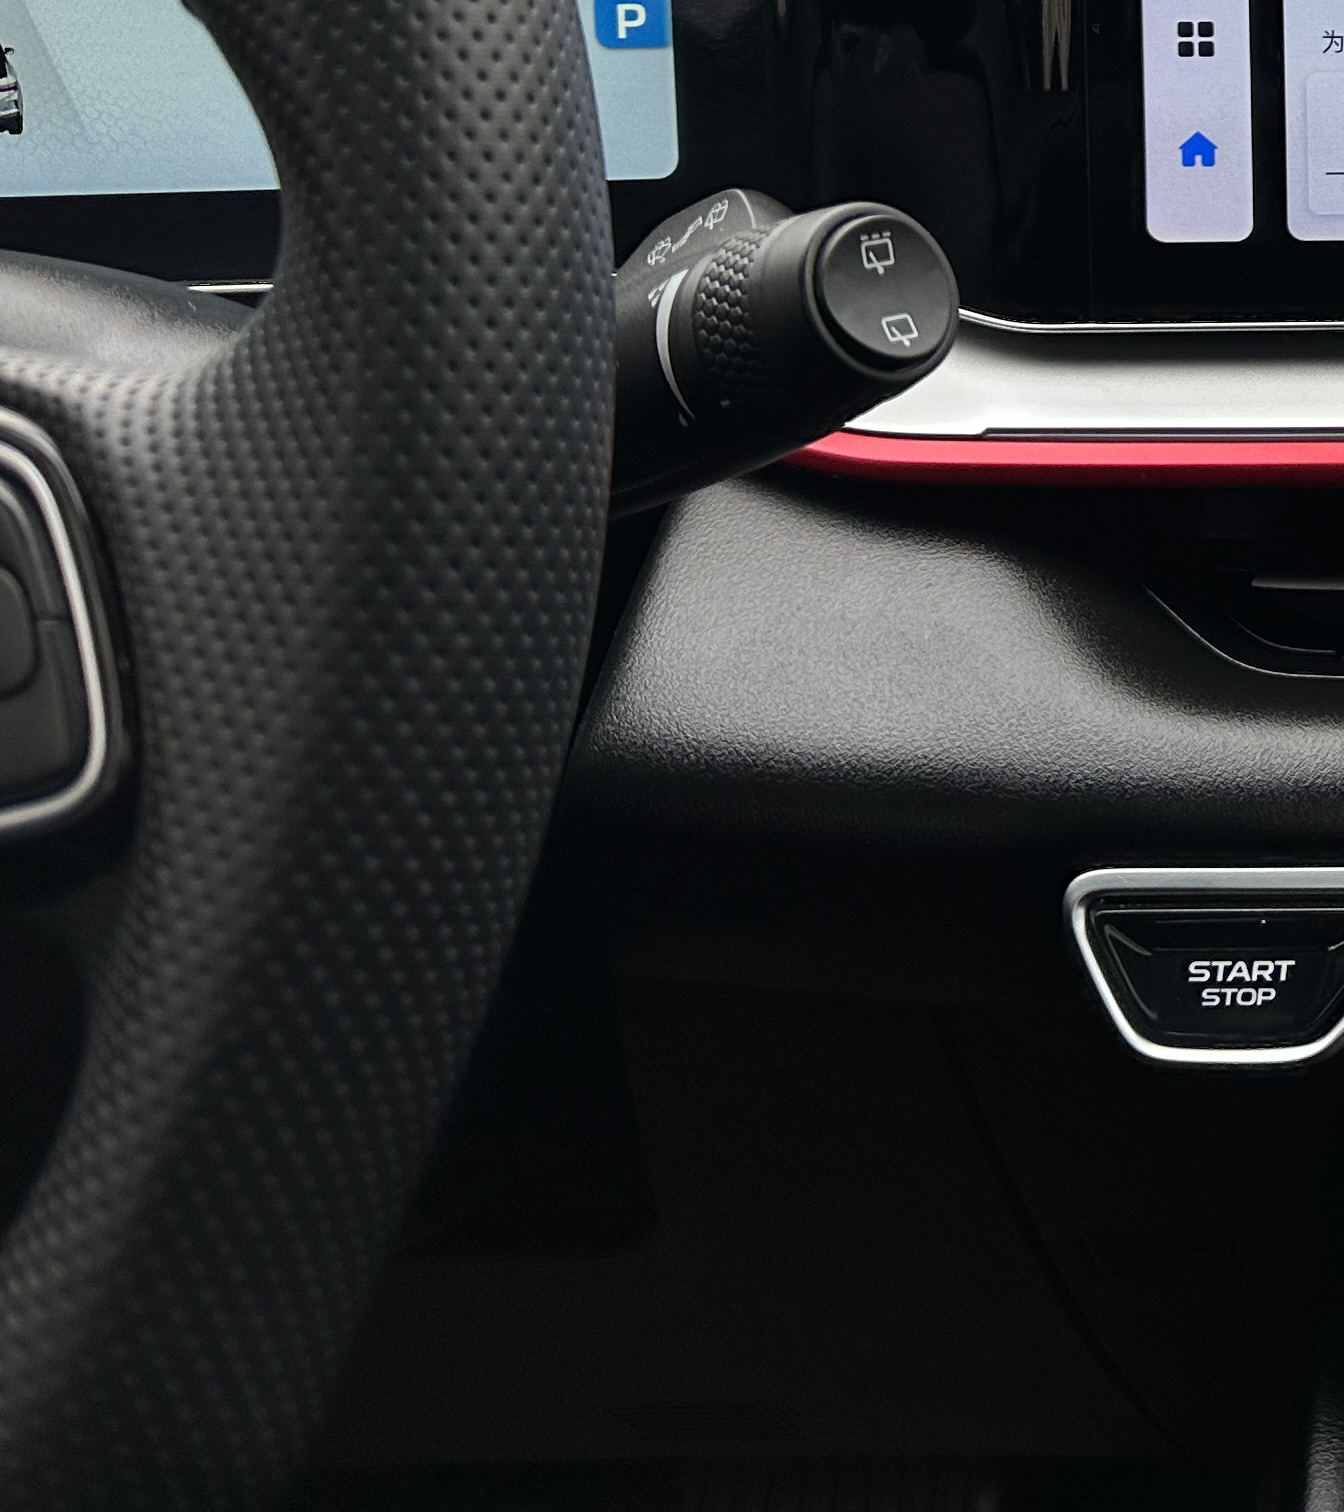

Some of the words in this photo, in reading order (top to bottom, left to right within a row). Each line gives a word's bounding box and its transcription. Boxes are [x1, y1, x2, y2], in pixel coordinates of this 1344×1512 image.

[616, 4, 647, 39] P
[1187, 959, 1296, 983] START
[1201, 987, 1277, 1007] STOP
